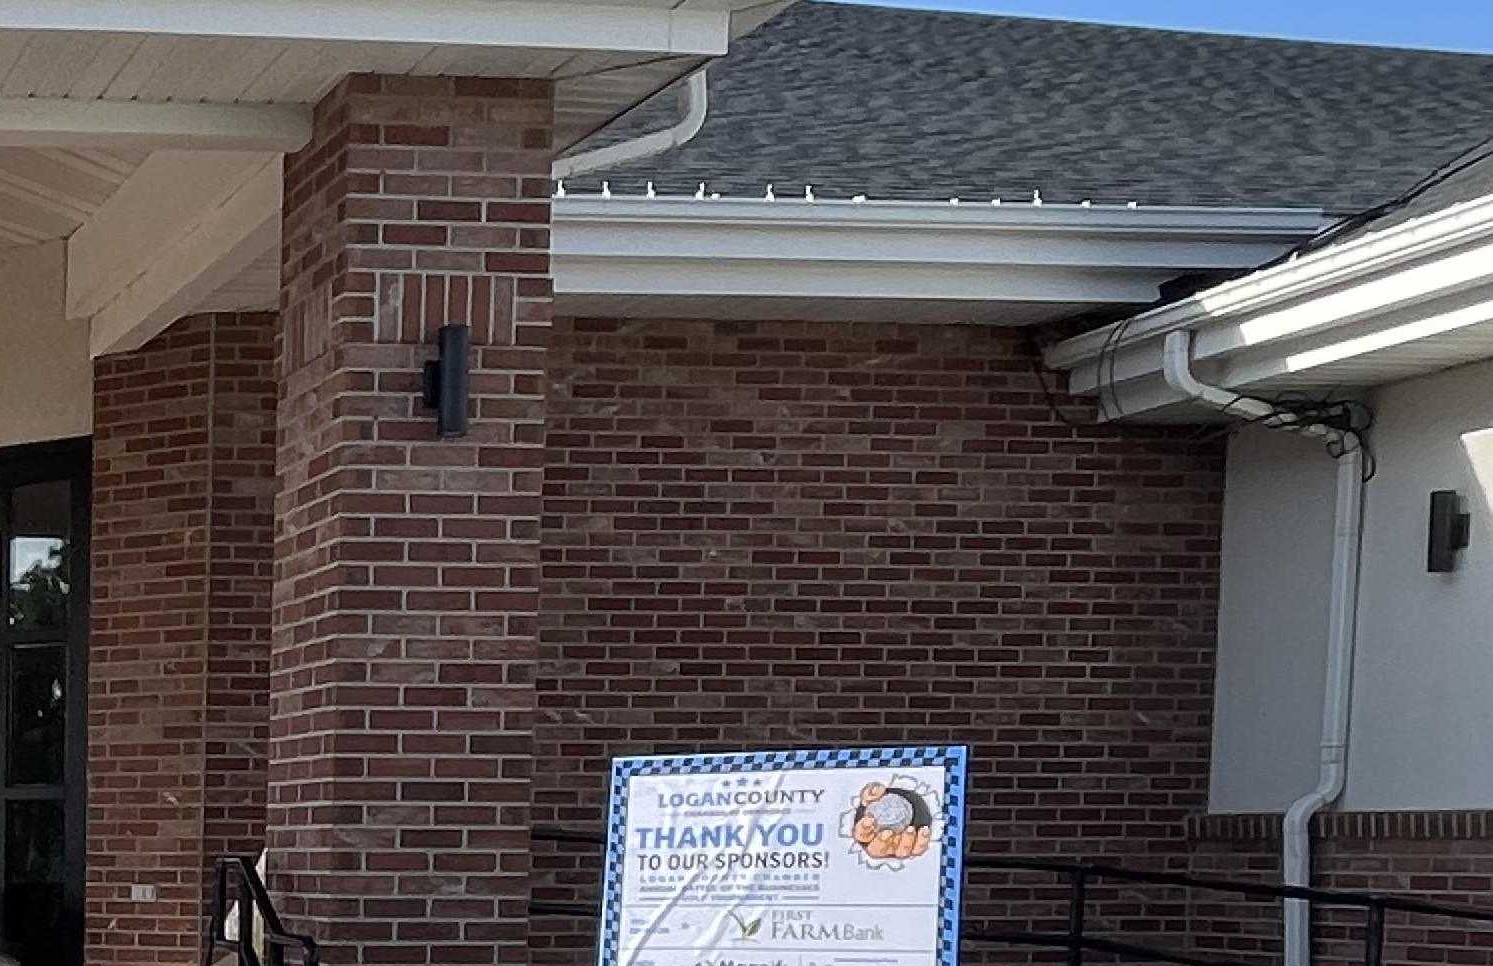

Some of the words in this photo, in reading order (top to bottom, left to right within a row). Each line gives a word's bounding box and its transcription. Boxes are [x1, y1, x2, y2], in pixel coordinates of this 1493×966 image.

[635, 824, 745, 849] THANK
[756, 823, 824, 847] YOU
[637, 854, 661, 871] TO
[668, 853, 708, 871] OUR
[715, 851, 830, 870] SPONSORS!
[772, 909, 811, 920] FIRST
